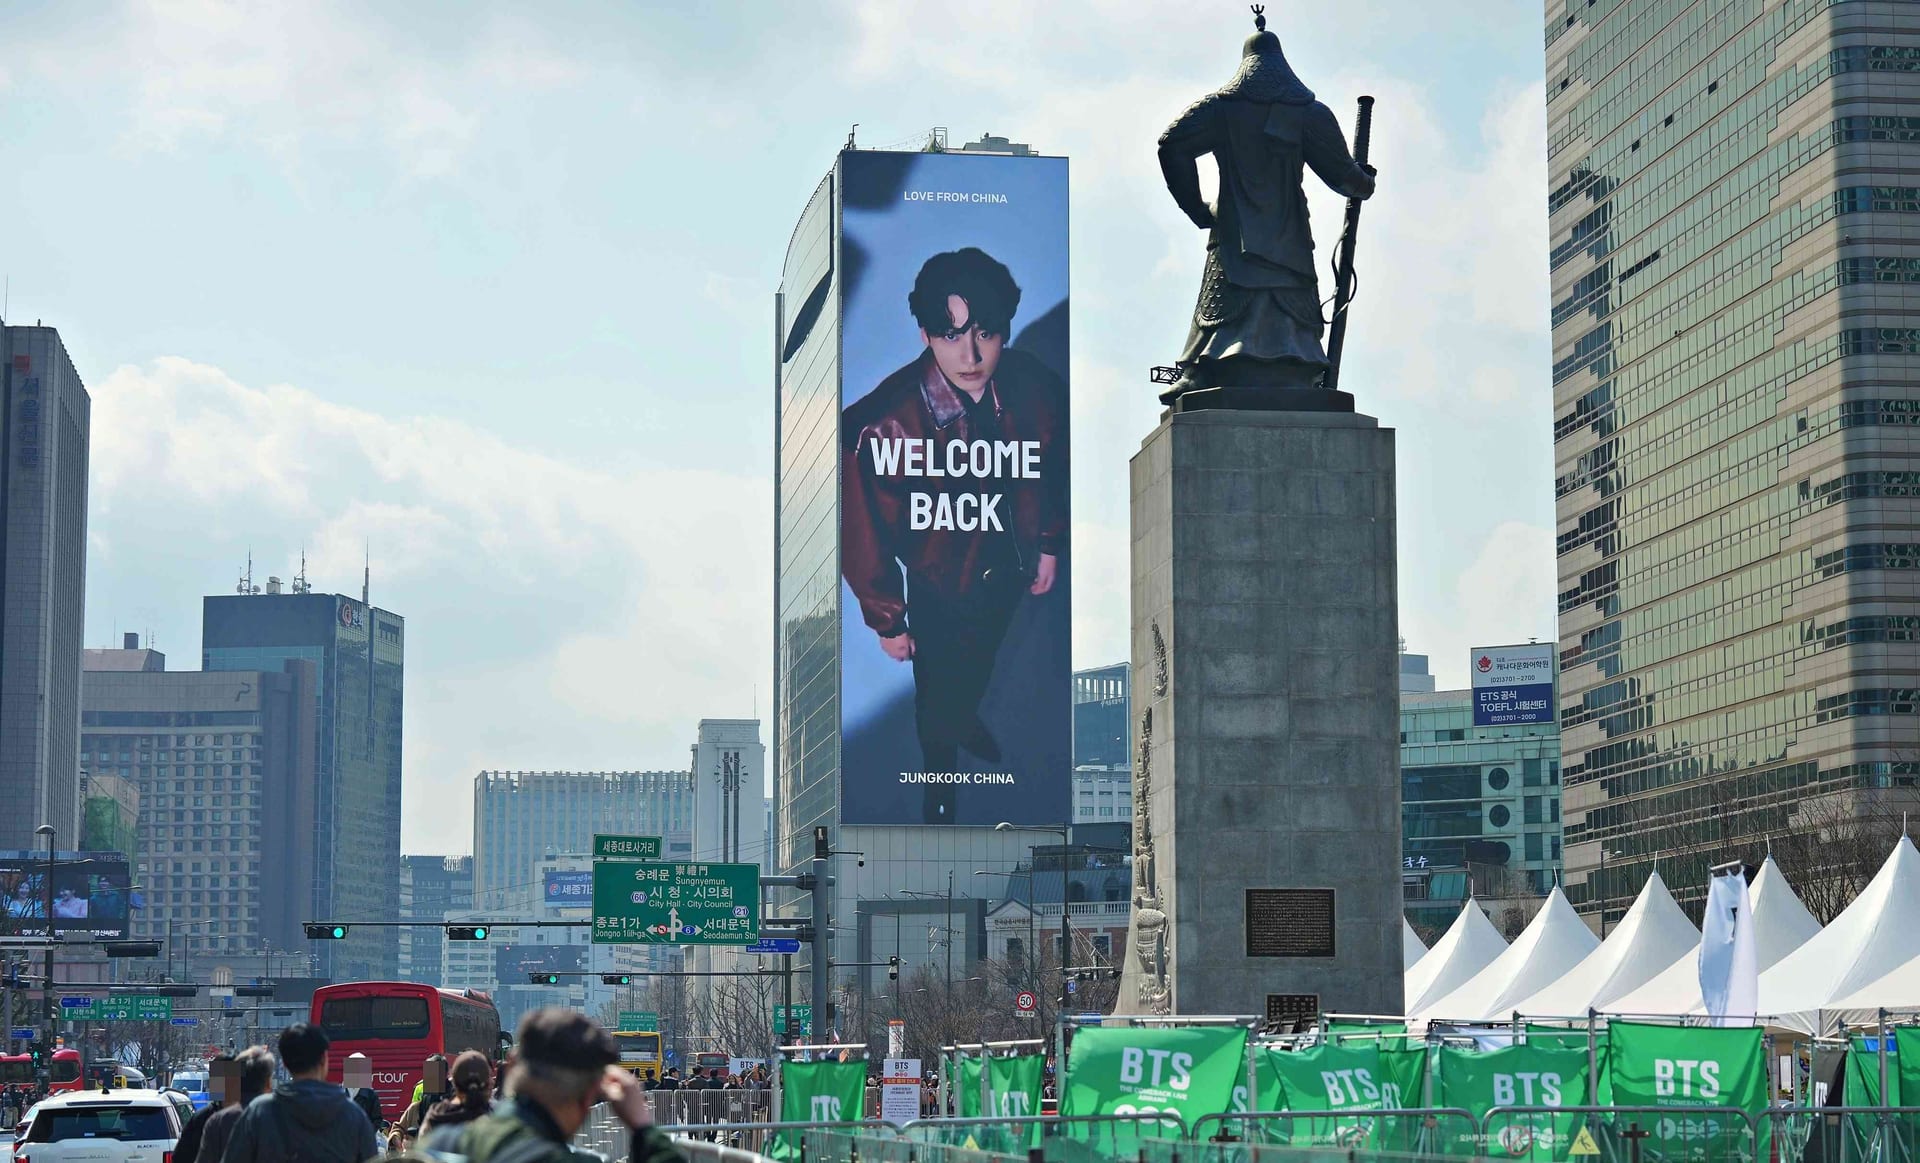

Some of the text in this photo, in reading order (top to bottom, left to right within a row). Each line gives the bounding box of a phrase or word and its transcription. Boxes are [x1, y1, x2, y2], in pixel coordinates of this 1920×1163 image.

[904, 191, 1008, 204] LOVE FROM CHINA
[870, 437, 1041, 479] WELCOME
[910, 492, 1004, 532] BACK
[1480, 690, 1517, 701] ETS 공식
[1481, 700, 1546, 712] TOEFL 시험센터
[899, 772, 1015, 784] JUNGKOOK CHINA
[602, 840, 655, 853] 세종대로사거리
[634, 869, 670, 881] 숭례문
[675, 877, 726, 887] Sungnyemun
[561, 884, 592, 895] 세종기
[693, 886, 733, 899] 시의회
[634, 893, 644, 901] 60
[648, 900, 733, 909] City Hall City Council
[596, 916, 640, 929] 종로1가
[704, 918, 750, 930] 서대문역
[596, 930, 621, 939] Jongno
[703, 931, 757, 940] Seodaemun Stn
[1020, 996, 1032, 1007] 50
[740, 1061, 754, 1069] BTS
[894, 1062, 909, 1070] BTS
[1120, 1047, 1193, 1091] BTS
[371, 1072, 409, 1083] rtour
[1655, 1059, 1719, 1098] BTS
[1321, 1068, 1379, 1106] BTS
[1493, 1072, 1562, 1107] BTS
